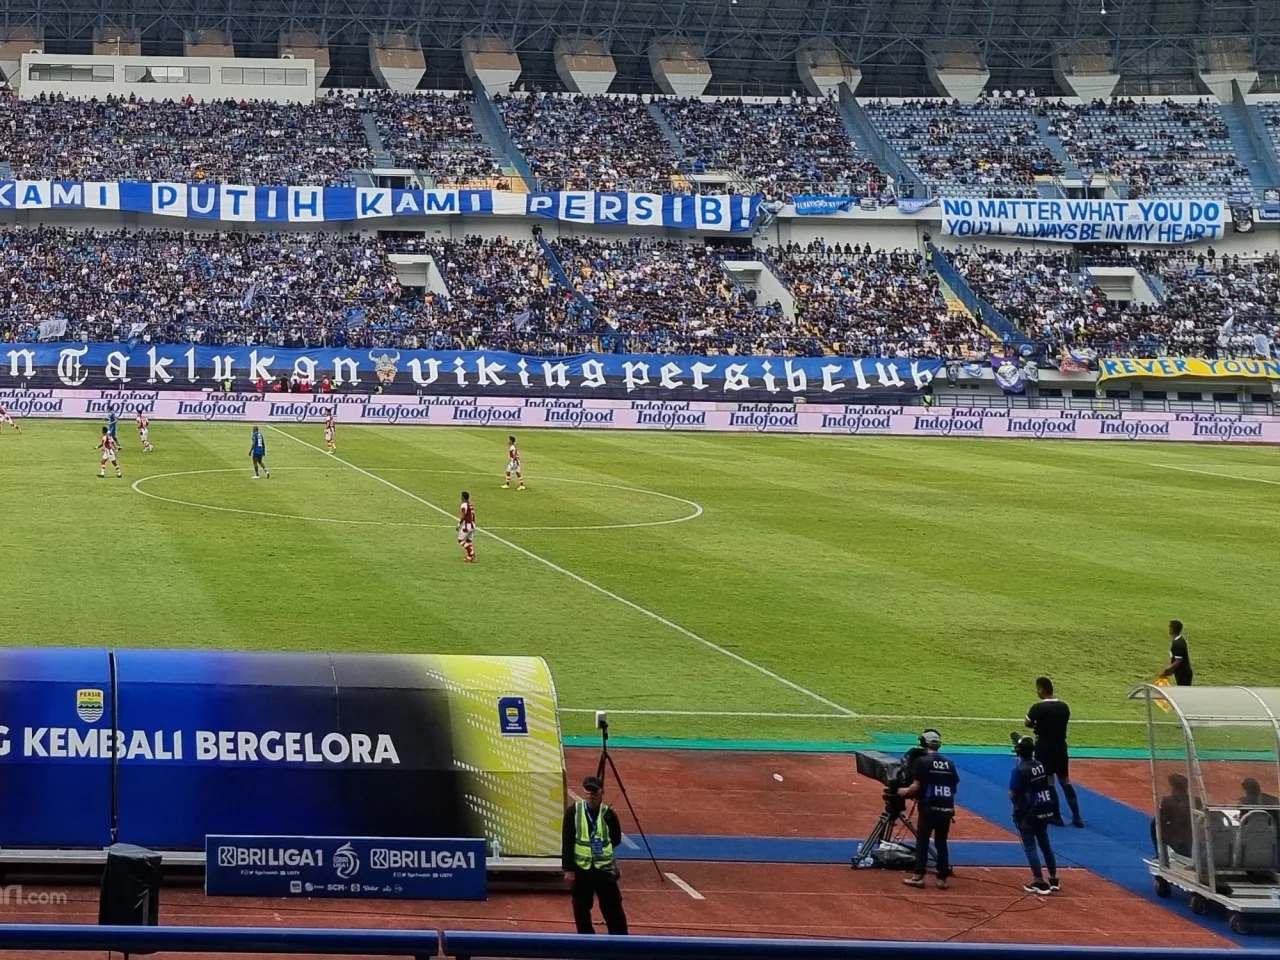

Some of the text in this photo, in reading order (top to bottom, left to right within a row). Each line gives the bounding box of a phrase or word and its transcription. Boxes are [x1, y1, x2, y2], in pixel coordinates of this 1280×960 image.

[158, 187, 318, 217] PUTIH
[361, 192, 480, 215] KAMI
[529, 194, 751, 228] PERSIB!
[943, 200, 973, 217] NO
[978, 200, 1062, 221] MATTER
[1067, 201, 1129, 222] WHAT
[1138, 202, 1183, 222] YOU
[1189, 202, 1220, 222] DO
[946, 219, 1221, 242] YOU'LL ALWAYS BE IN MY HEART
[178, 400, 246, 420] Indofood
[360, 403, 429, 423] Indofood
[452, 404, 521, 424] Indofood
[545, 407, 614, 427] Indofood
[636, 409, 706, 429] Indofood
[728, 410, 799, 431] Indofood
[821, 412, 891, 433] Indofood
[914, 414, 983, 435] Indofood
[1006, 416, 1076, 437] Indofood
[1100, 418, 1170, 439] Indofood
[1192, 420, 1262, 441] Indofood
[23, 727, 183, 760] KEMBALI
[195, 730, 400, 765] BERGELORA
[932, 760, 950, 770] 021
[934, 785, 952, 797] HB
